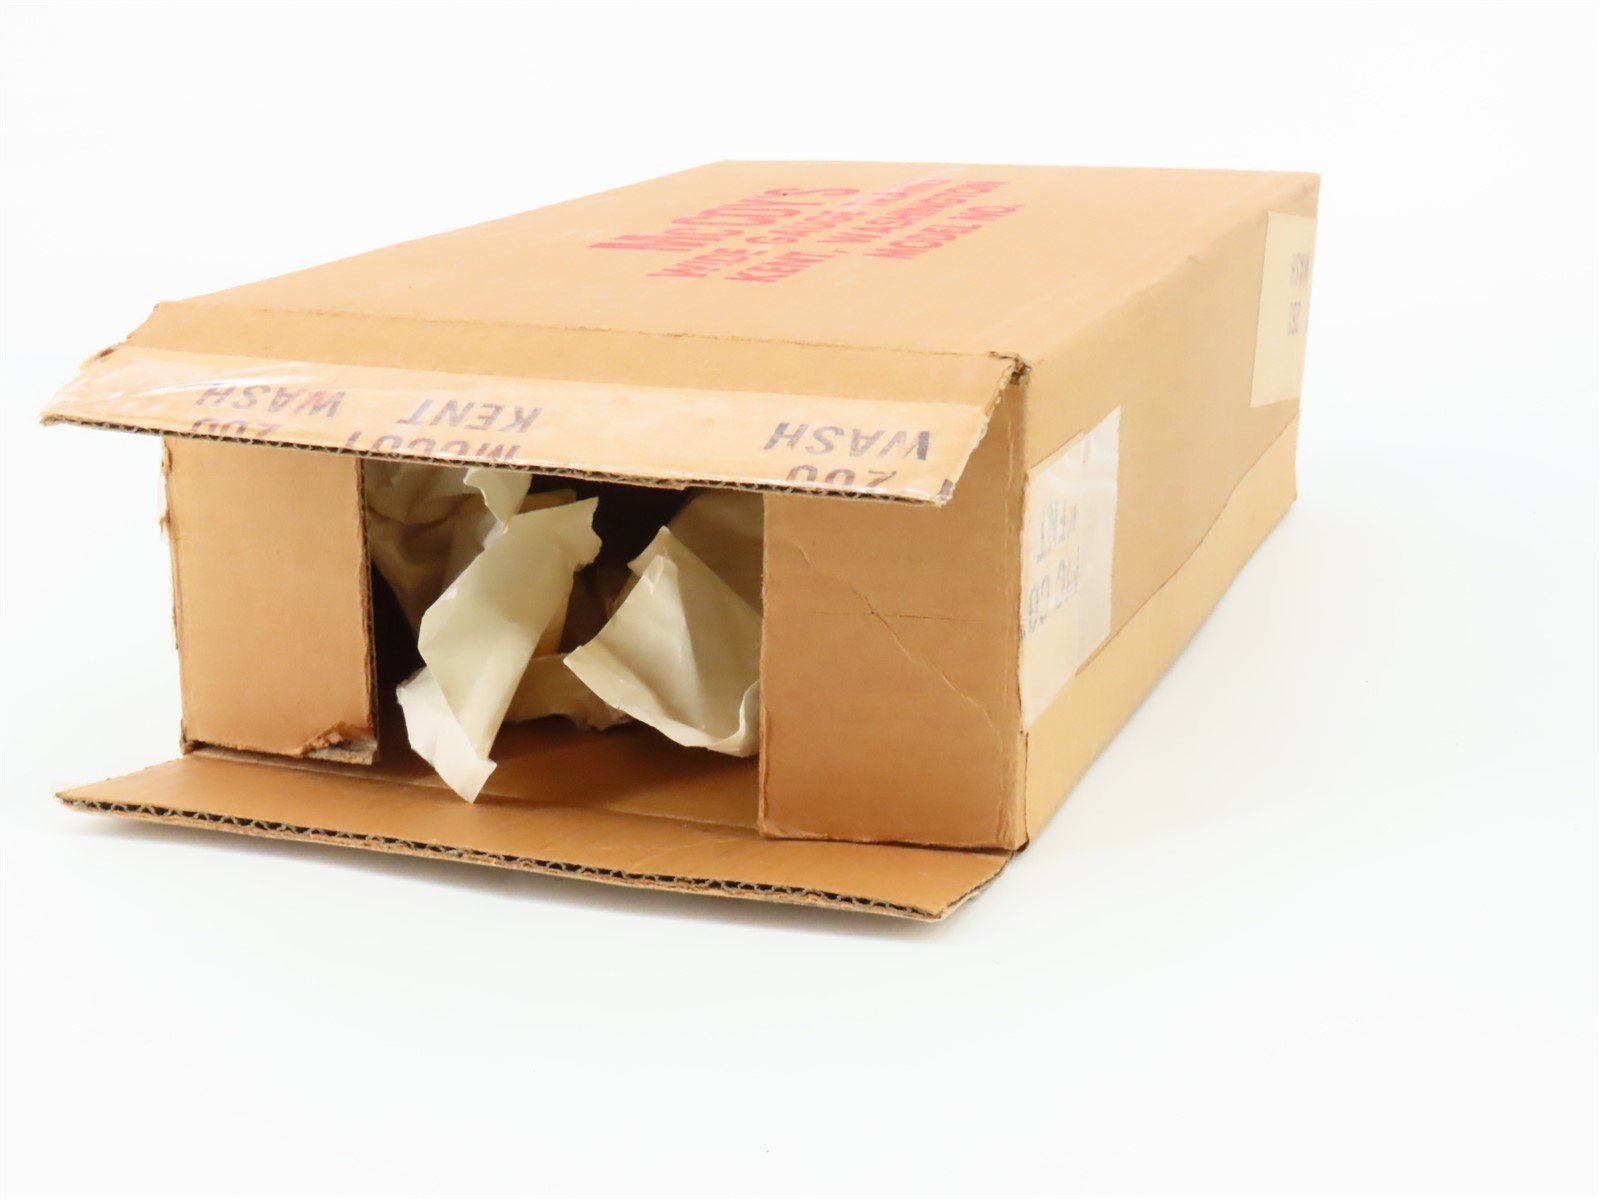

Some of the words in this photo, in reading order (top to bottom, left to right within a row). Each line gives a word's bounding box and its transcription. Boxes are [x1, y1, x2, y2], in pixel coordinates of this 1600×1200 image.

[816, 181, 1008, 242] WASHINGTON
[863, 224, 983, 260] MODEL
[947, 203, 1025, 222] NO.
[646, 248, 768, 277] WIDE
[745, 210, 867, 244] GAUGE
[193, 382, 347, 418] WASH
[399, 400, 542, 431] KENT
[764, 422, 930, 460] WASH
